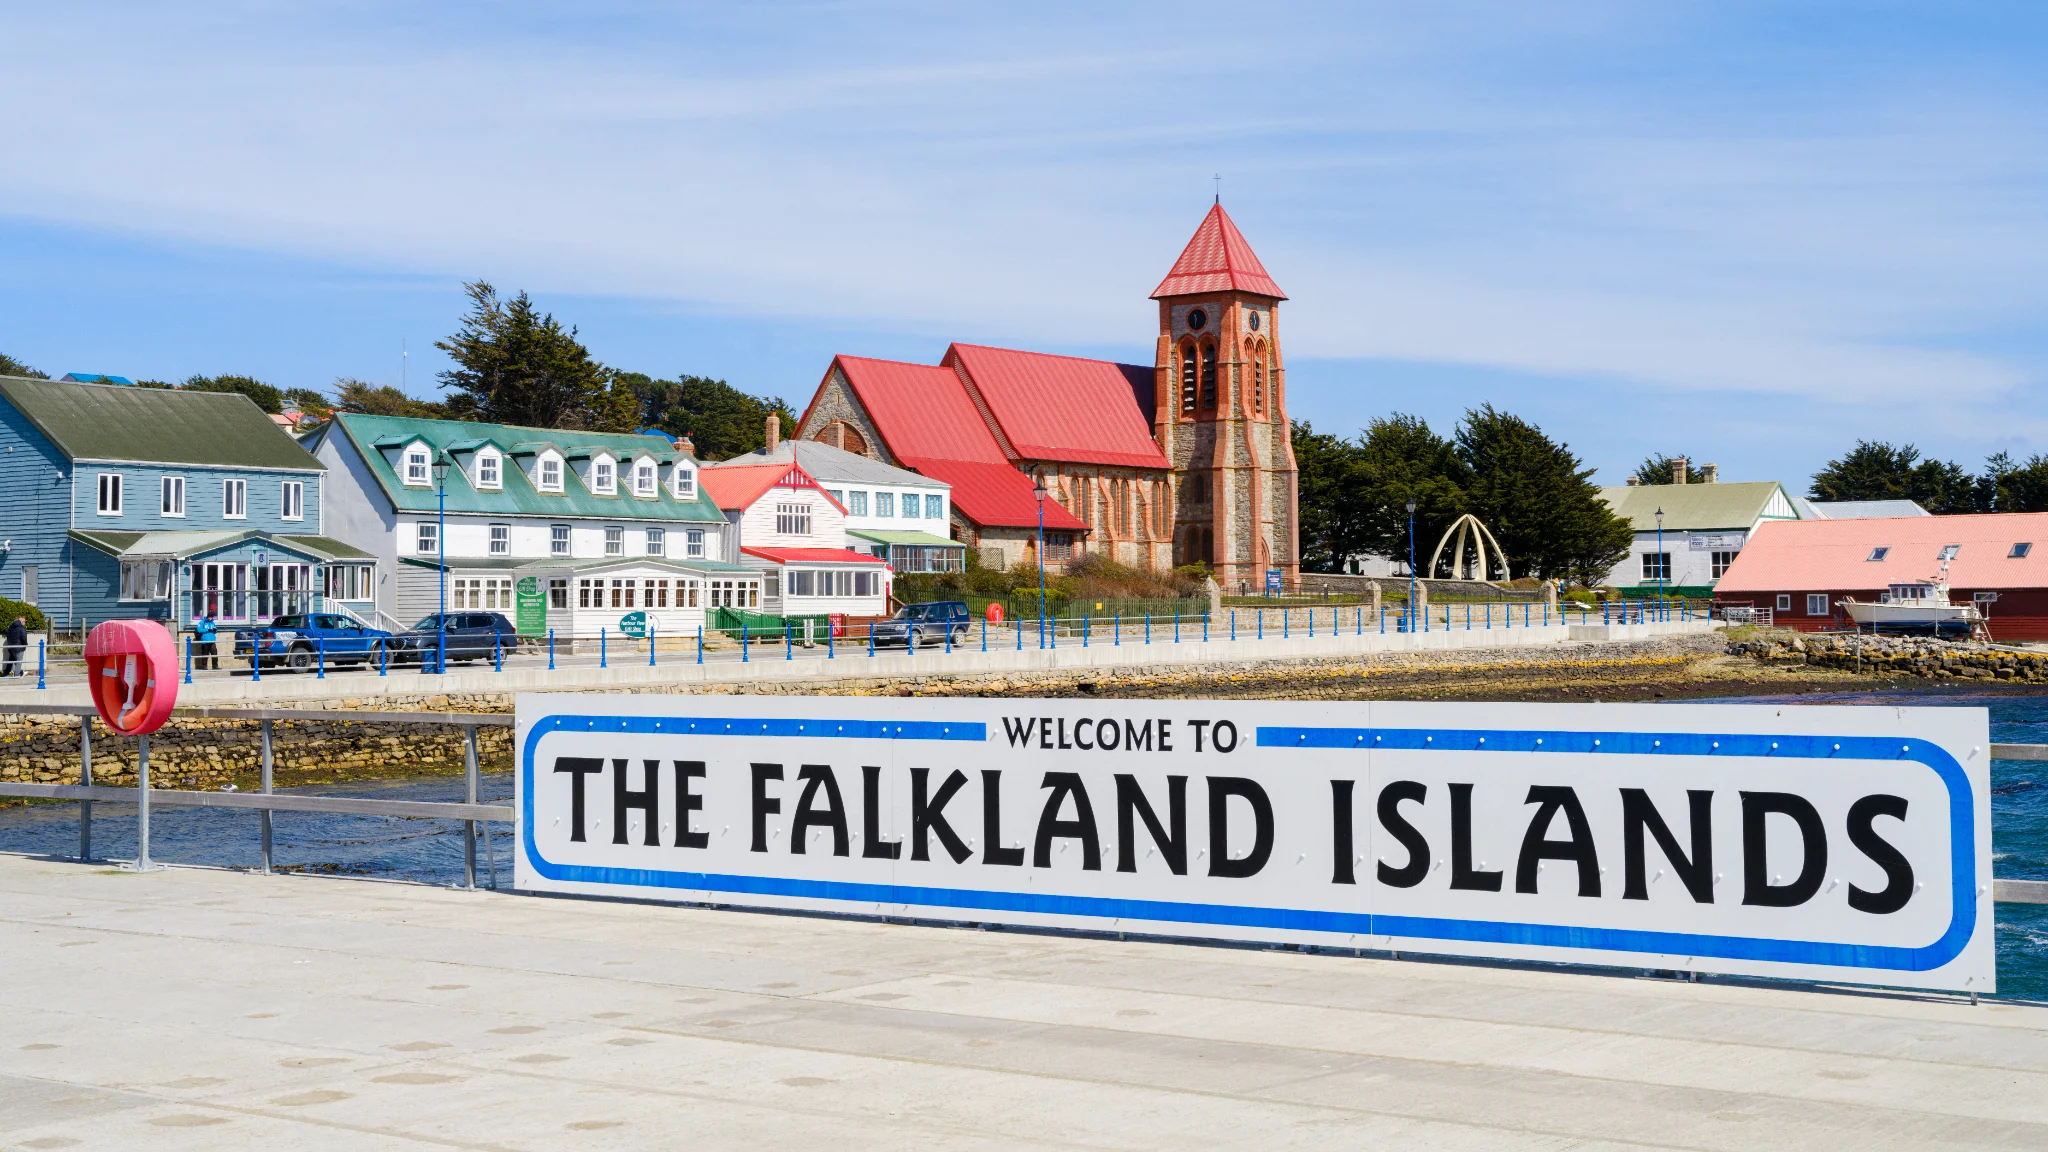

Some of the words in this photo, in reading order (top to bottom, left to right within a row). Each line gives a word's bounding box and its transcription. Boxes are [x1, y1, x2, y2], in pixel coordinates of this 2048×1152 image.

[1002, 717, 1173, 752] WELCOME
[1188, 720, 1238, 754] TO
[553, 757, 710, 849] THE
[750, 763, 1275, 879] FALKLAND
[1329, 780, 1915, 915] ISLANDS
